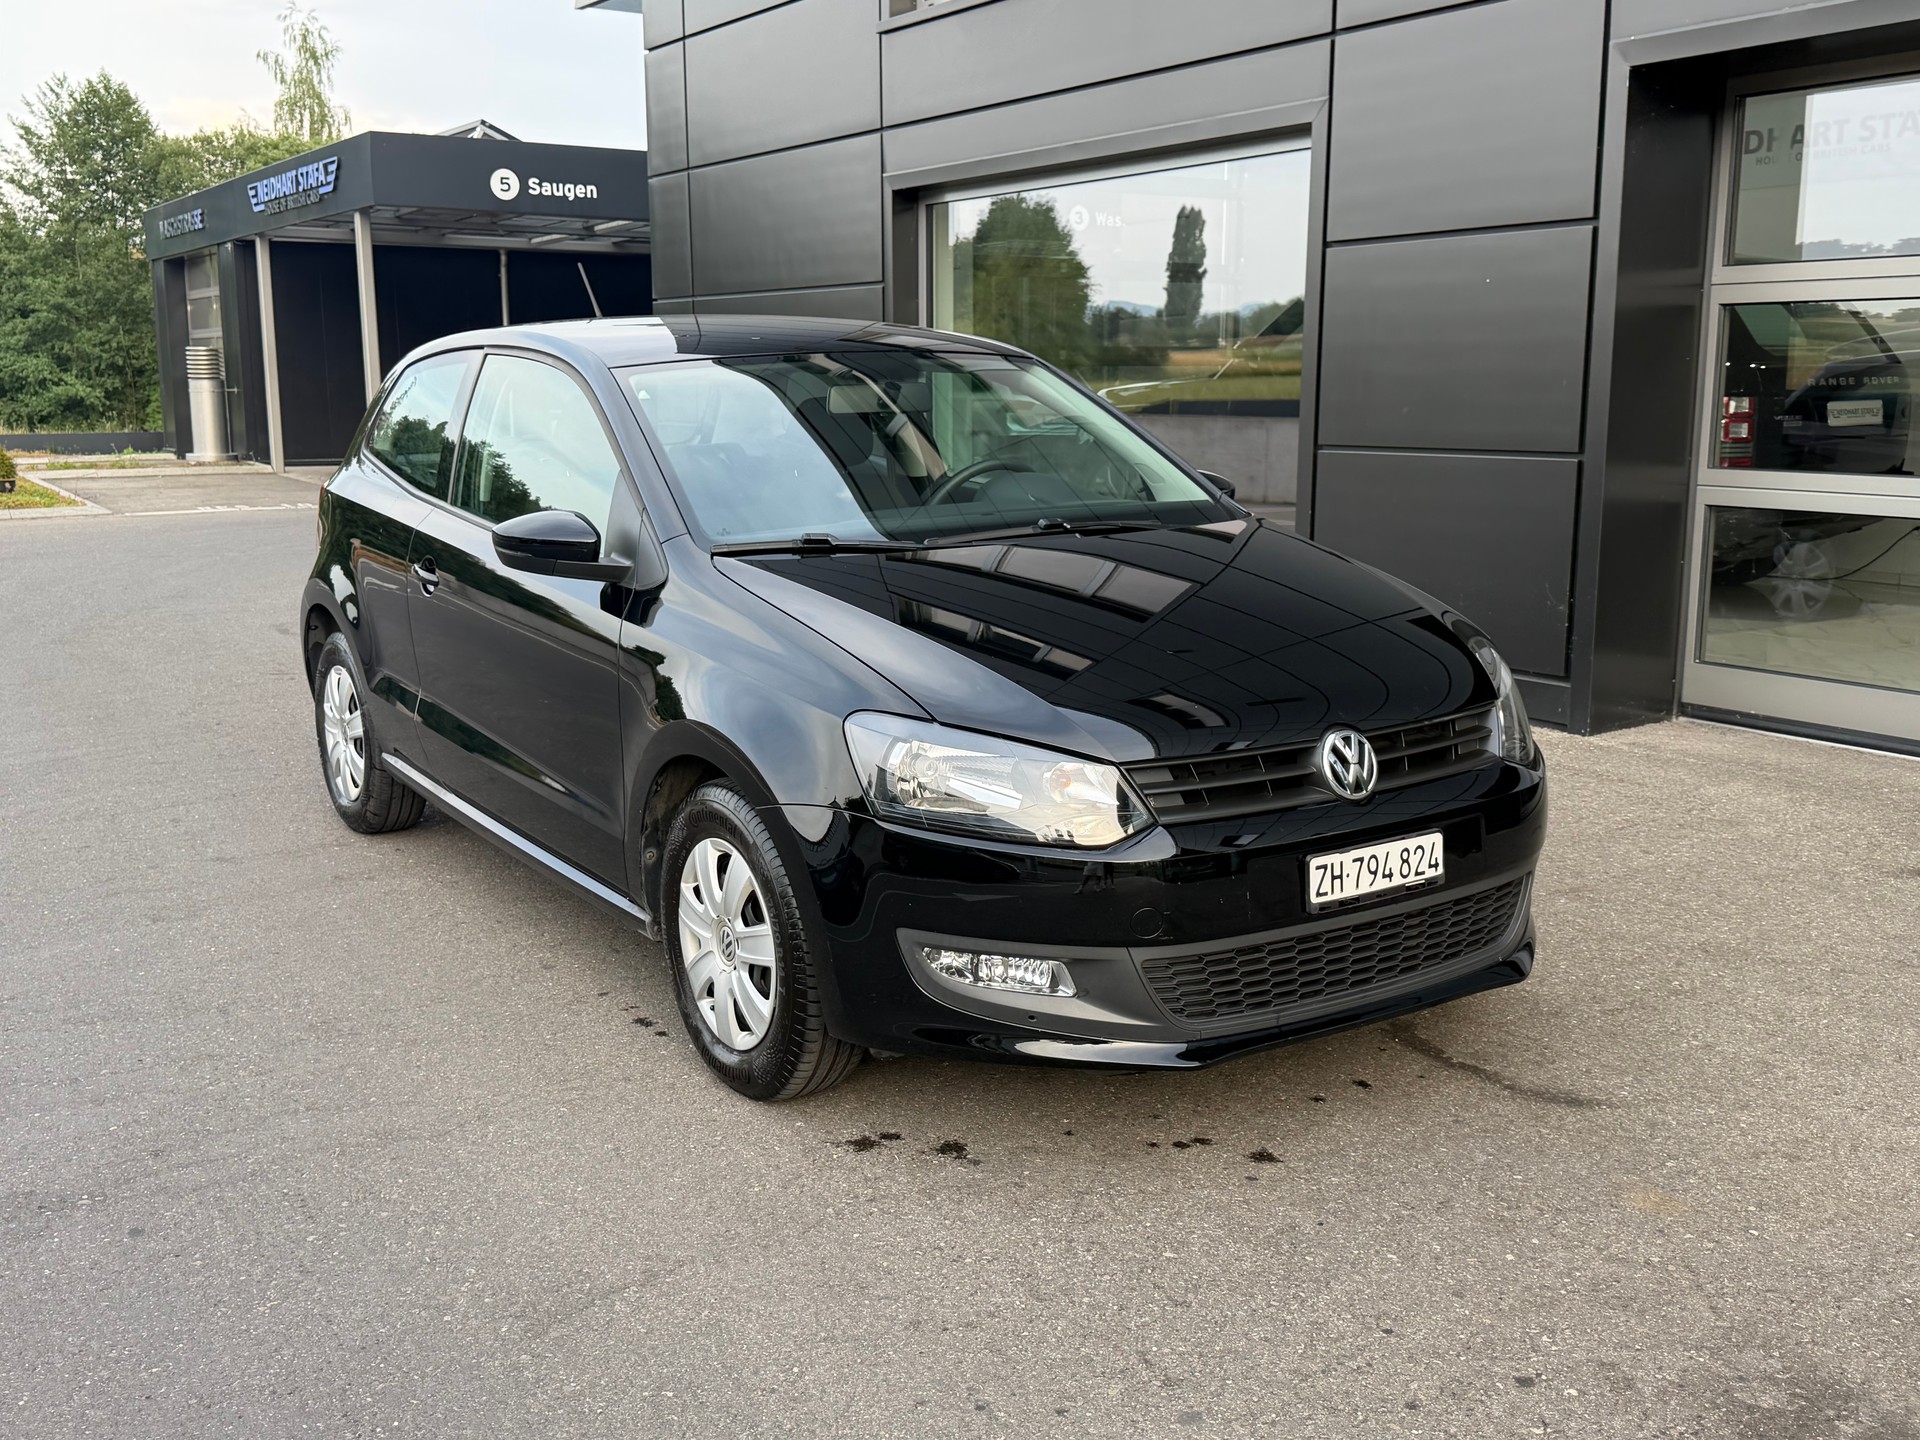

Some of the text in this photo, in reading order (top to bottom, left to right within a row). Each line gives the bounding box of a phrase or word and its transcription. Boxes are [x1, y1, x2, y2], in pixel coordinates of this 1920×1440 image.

[257, 169, 297, 204] NEIDHART
[500, 176, 598, 201] 5 Saugen
[1807, 376, 1900, 387] RANGE ROVER
[688, 805, 738, 838] Continental
[1399, 841, 1440, 879] 824
